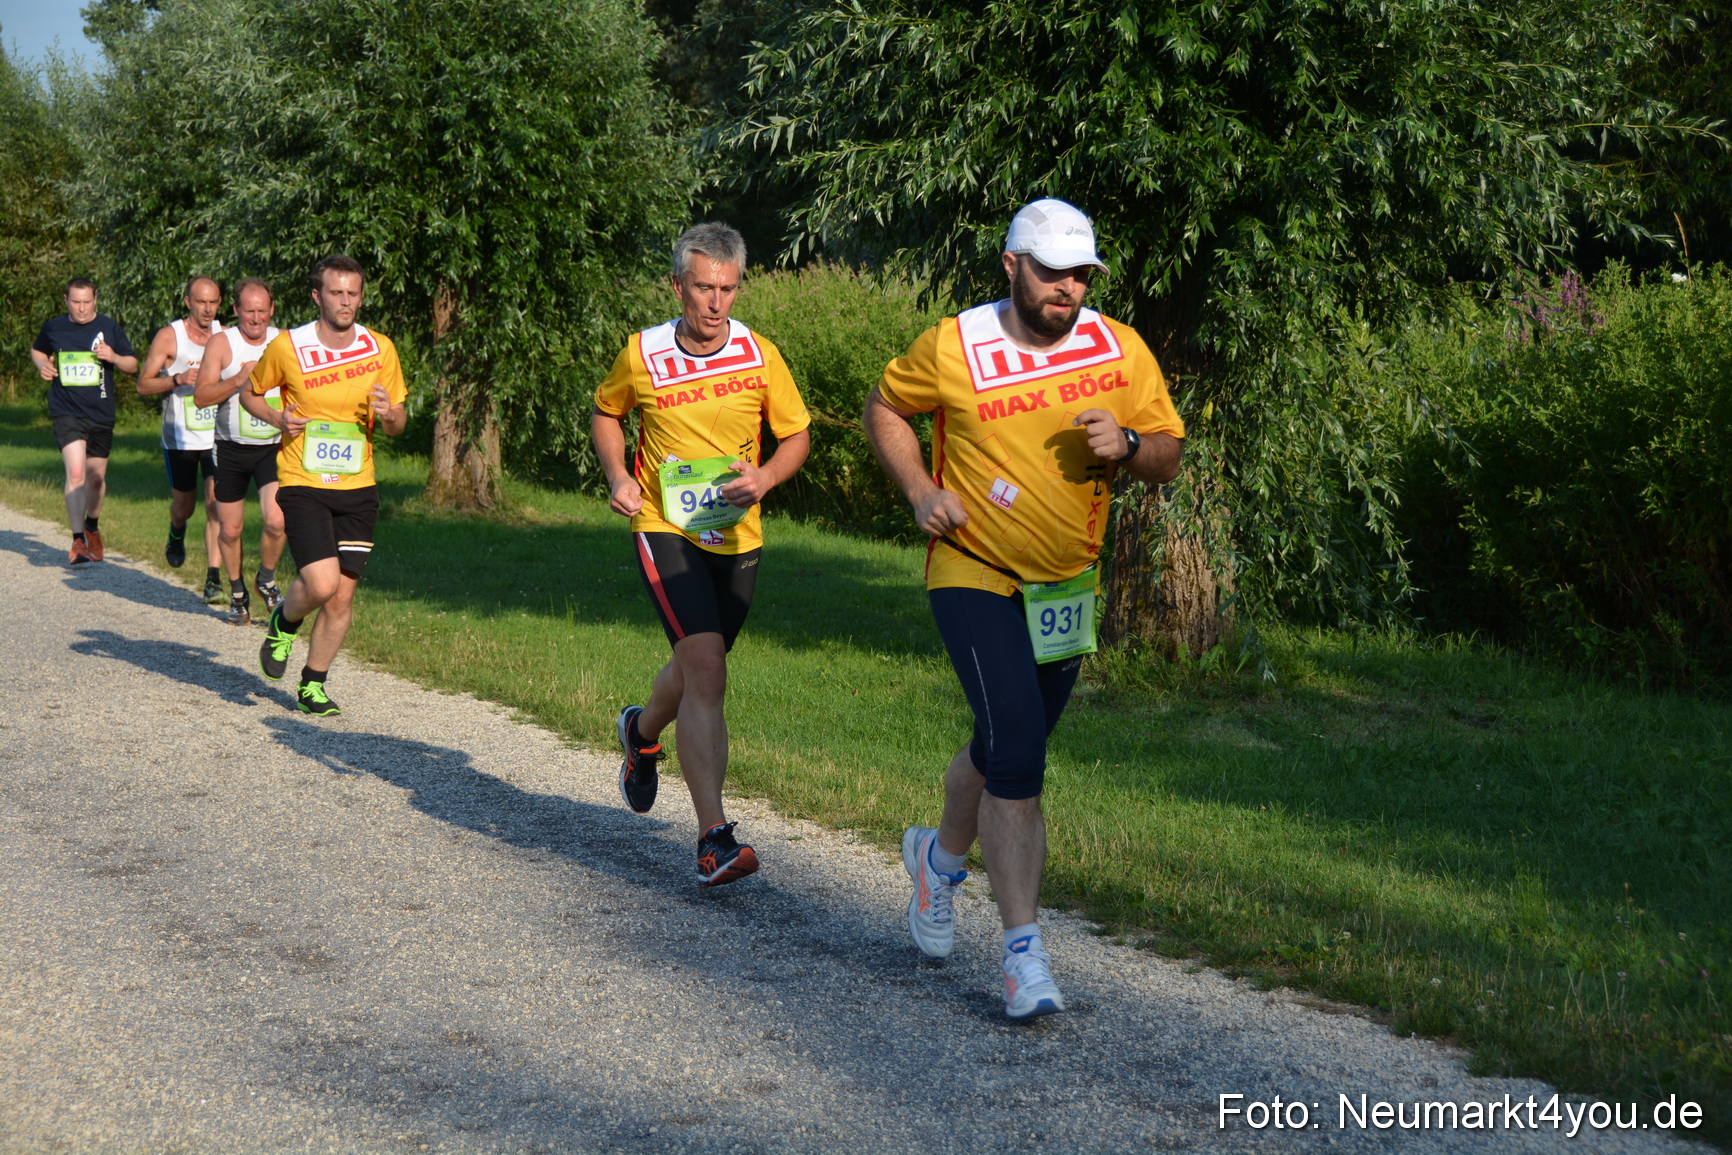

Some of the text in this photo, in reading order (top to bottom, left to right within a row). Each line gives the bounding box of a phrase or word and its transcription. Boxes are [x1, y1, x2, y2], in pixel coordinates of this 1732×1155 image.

[63, 365, 95, 377] 1127
[304, 360, 383, 390] MAX BÖGL
[656, 375, 768, 410] MAX BÖGL
[977, 370, 1129, 422] MAX BÖGL
[316, 442, 352, 461] 864
[680, 485, 730, 513] 949
[1040, 602, 1083, 637] 931
